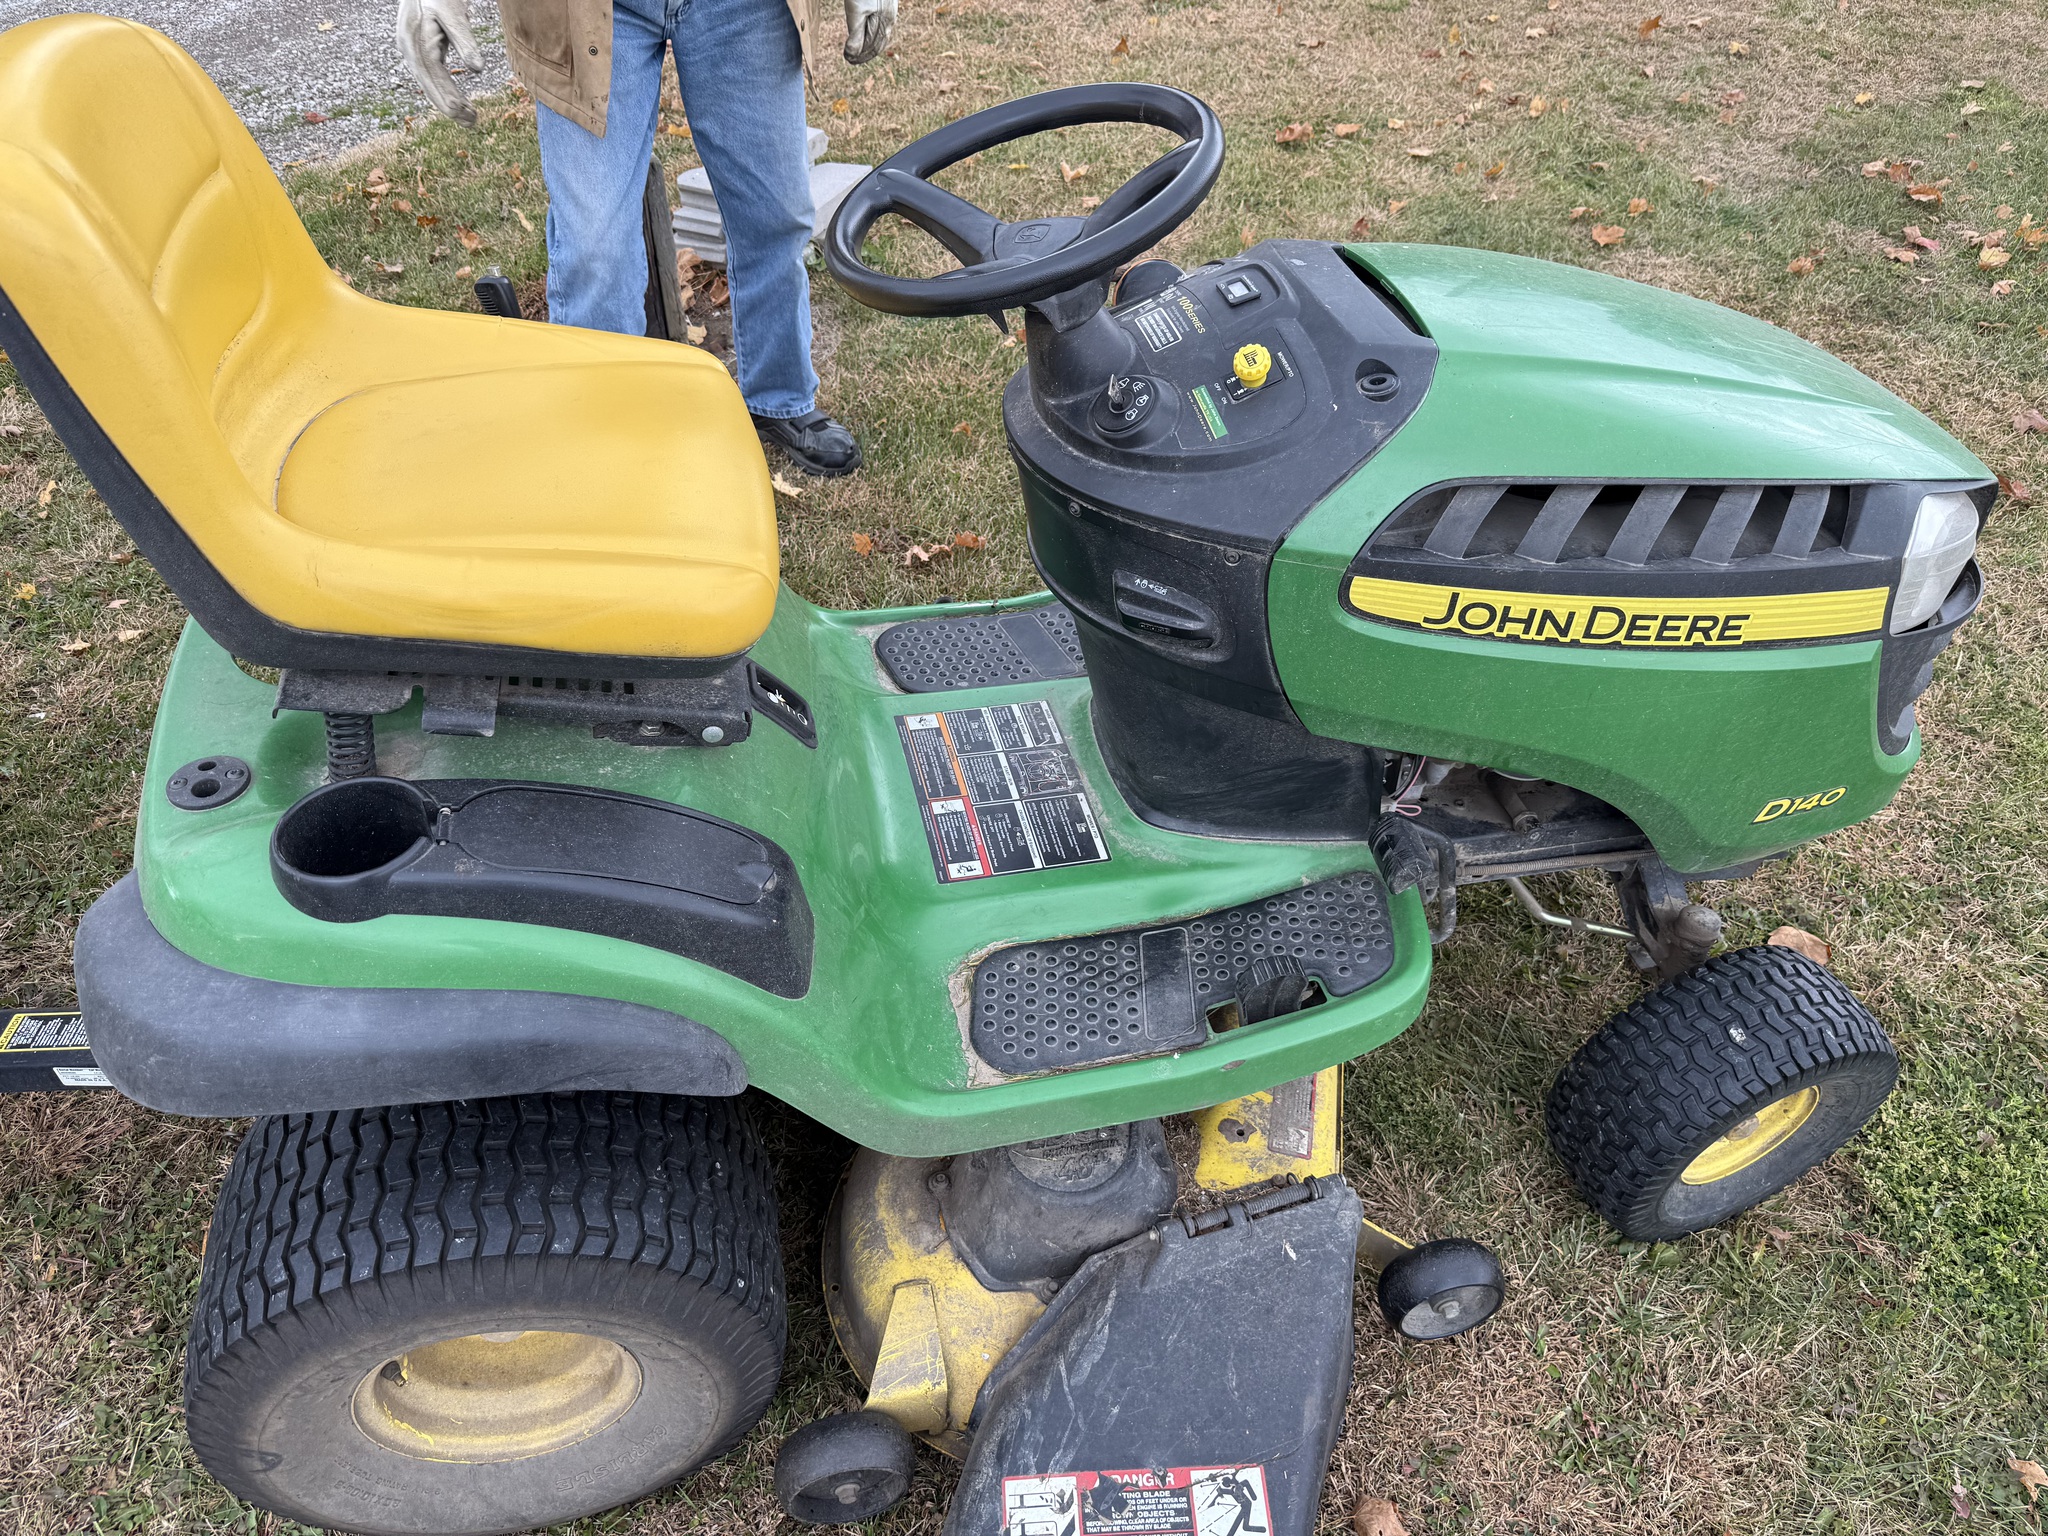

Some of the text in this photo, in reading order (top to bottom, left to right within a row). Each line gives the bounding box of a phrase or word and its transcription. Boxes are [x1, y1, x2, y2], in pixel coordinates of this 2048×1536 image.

[1423, 591, 1751, 643] JOHN DEERE
[1753, 787, 1847, 824] D140
[972, 827, 981, 845] DANGER
[555, 1423, 668, 1493] CARLISLE
[1109, 1472, 1175, 1488] DANGR
[1142, 1490, 1171, 1498] BLADE
[1137, 1510, 1176, 1518] OBJECTS
